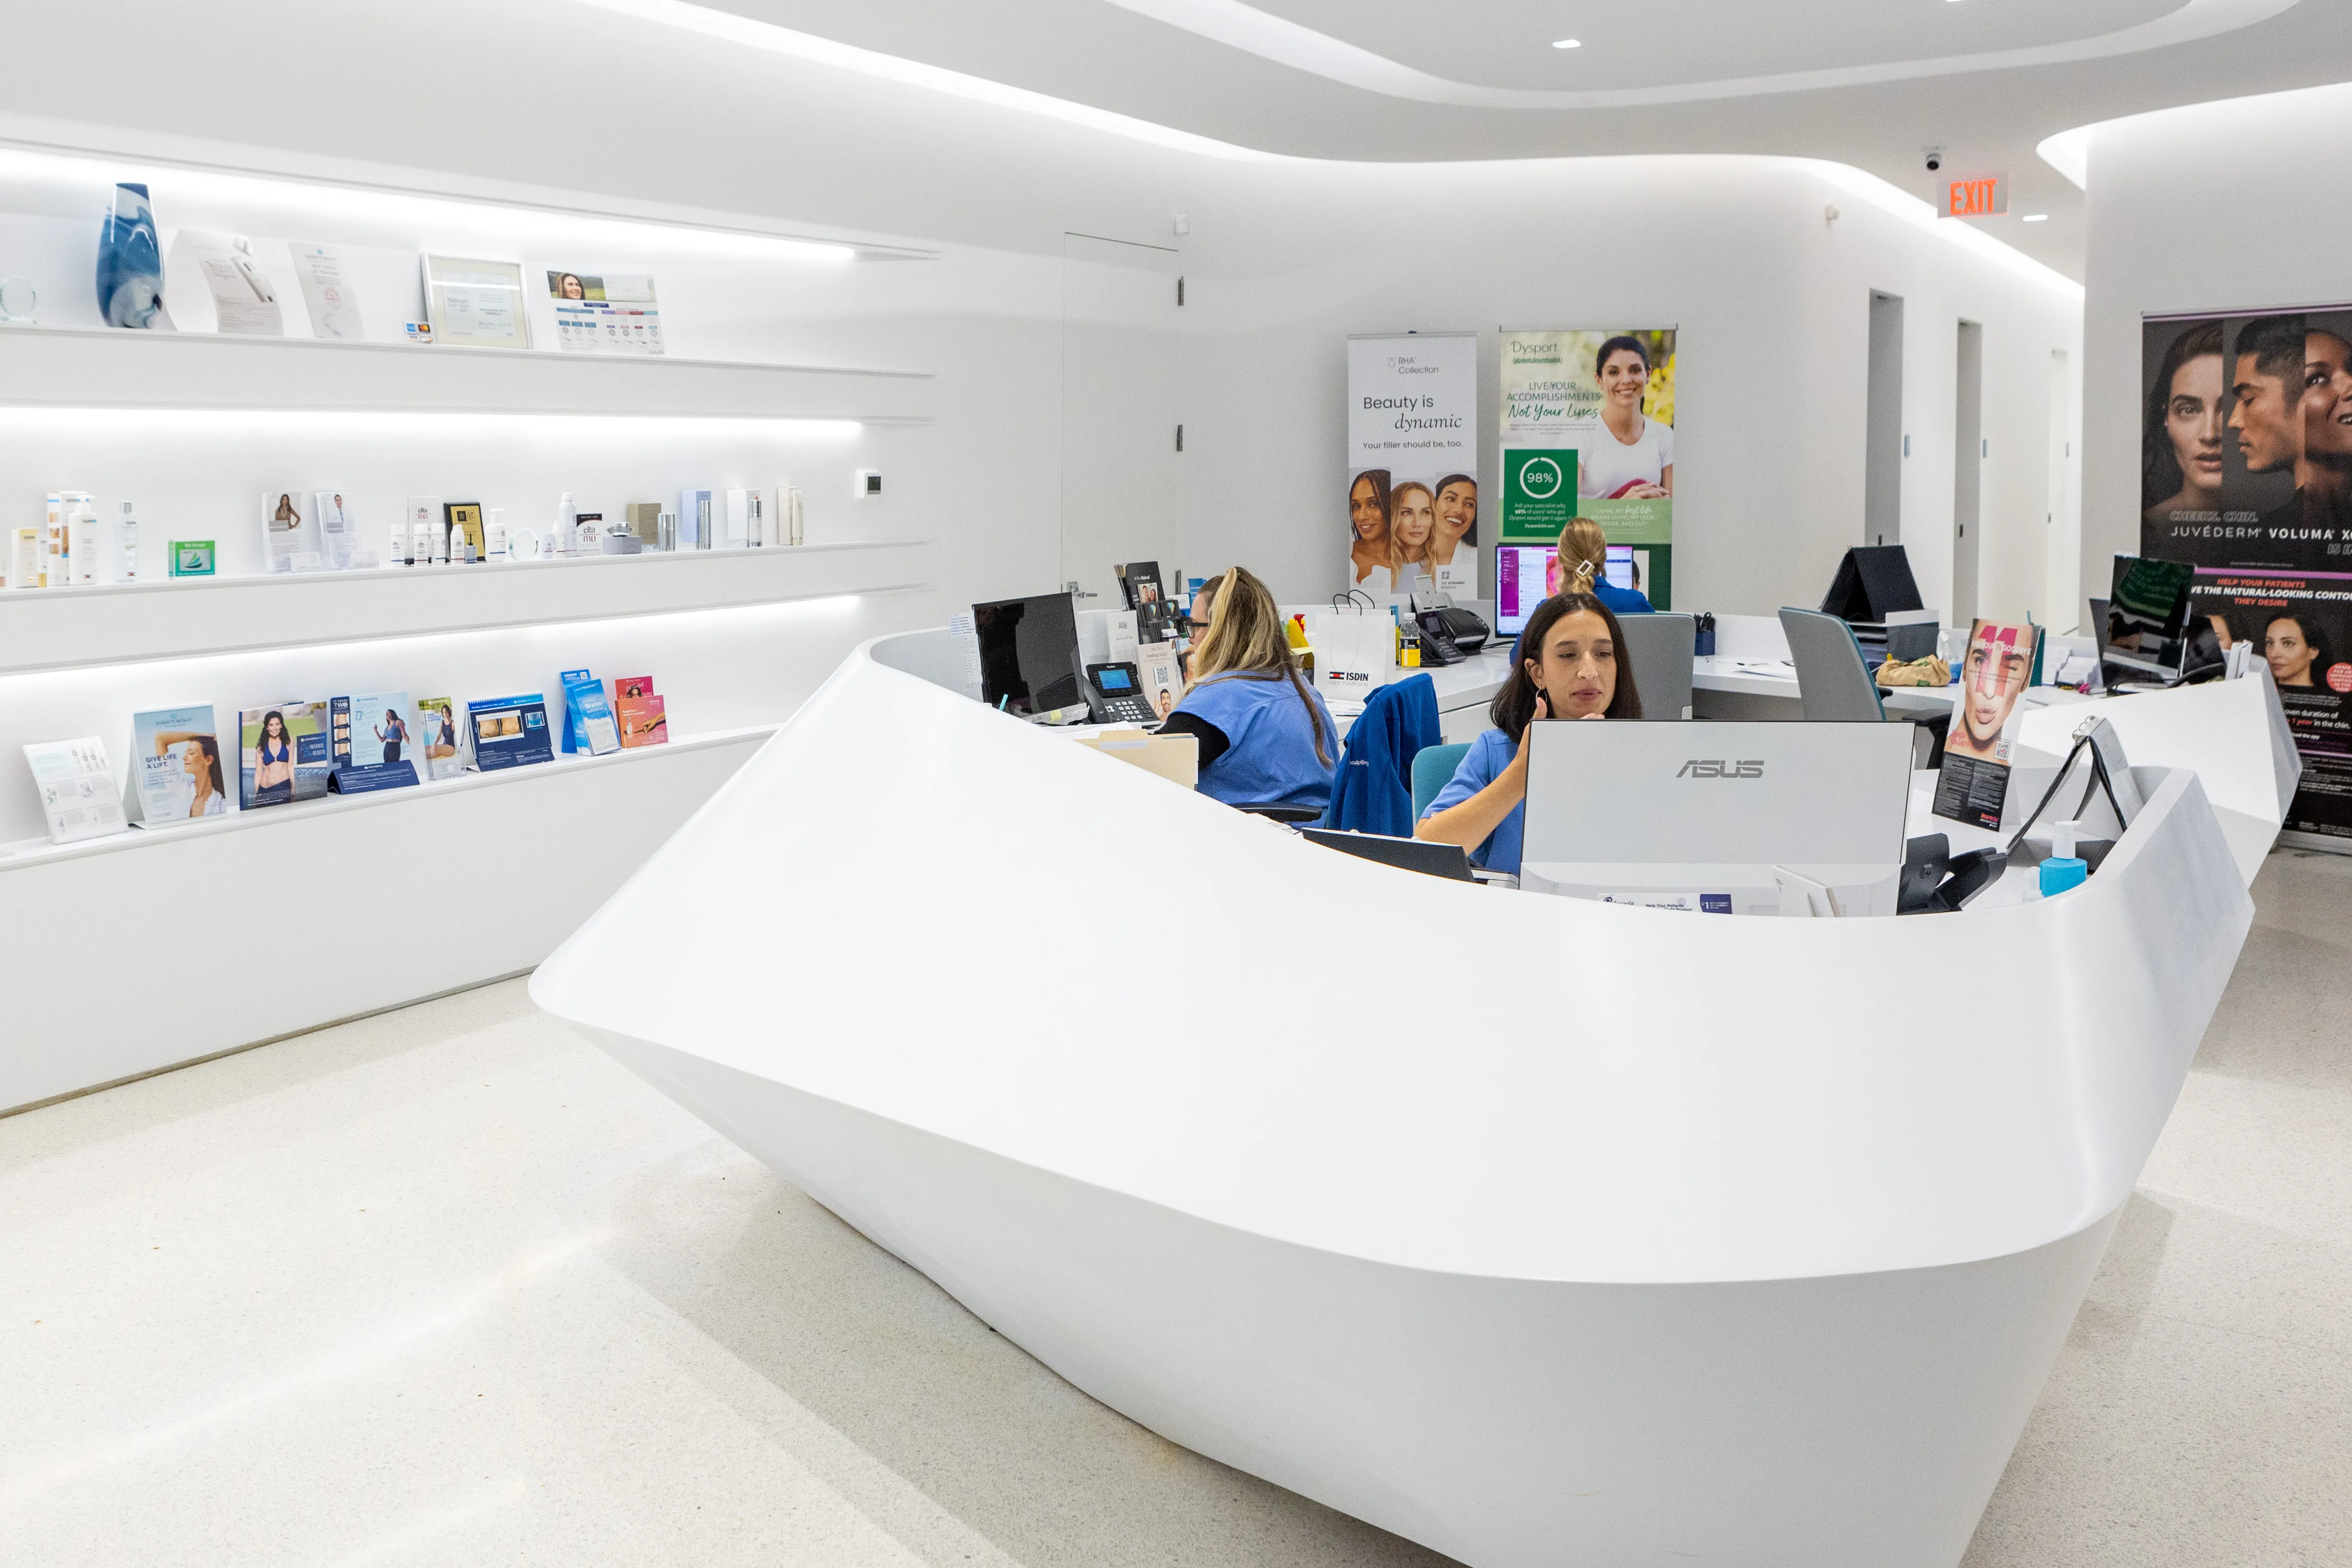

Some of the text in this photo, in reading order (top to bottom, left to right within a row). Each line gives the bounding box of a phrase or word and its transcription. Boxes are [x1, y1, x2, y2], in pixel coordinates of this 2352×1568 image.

[1950, 178, 1997, 215] EXIT
[1510, 340, 1558, 355] Dysport
[1529, 381, 1576, 390] LIVE YOUR
[1363, 395, 1434, 412] Beauty is
[1508, 403, 1598, 421] Not Your Lines
[1395, 413, 1462, 433] dynamic
[1526, 472, 1554, 484] 98%
[2240, 579, 2263, 587] YOUR
[2265, 579, 2306, 588] PATIENTS
[2204, 586, 2222, 595] THE
[2223, 587, 2313, 599] NATURAL-LOOKING
[2234, 597, 2288, 607] THEY DESIRE
[1346, 672, 1369, 681] ISDIN
[2301, 710, 2330, 718] duration
[1676, 760, 1765, 779] ASUS
